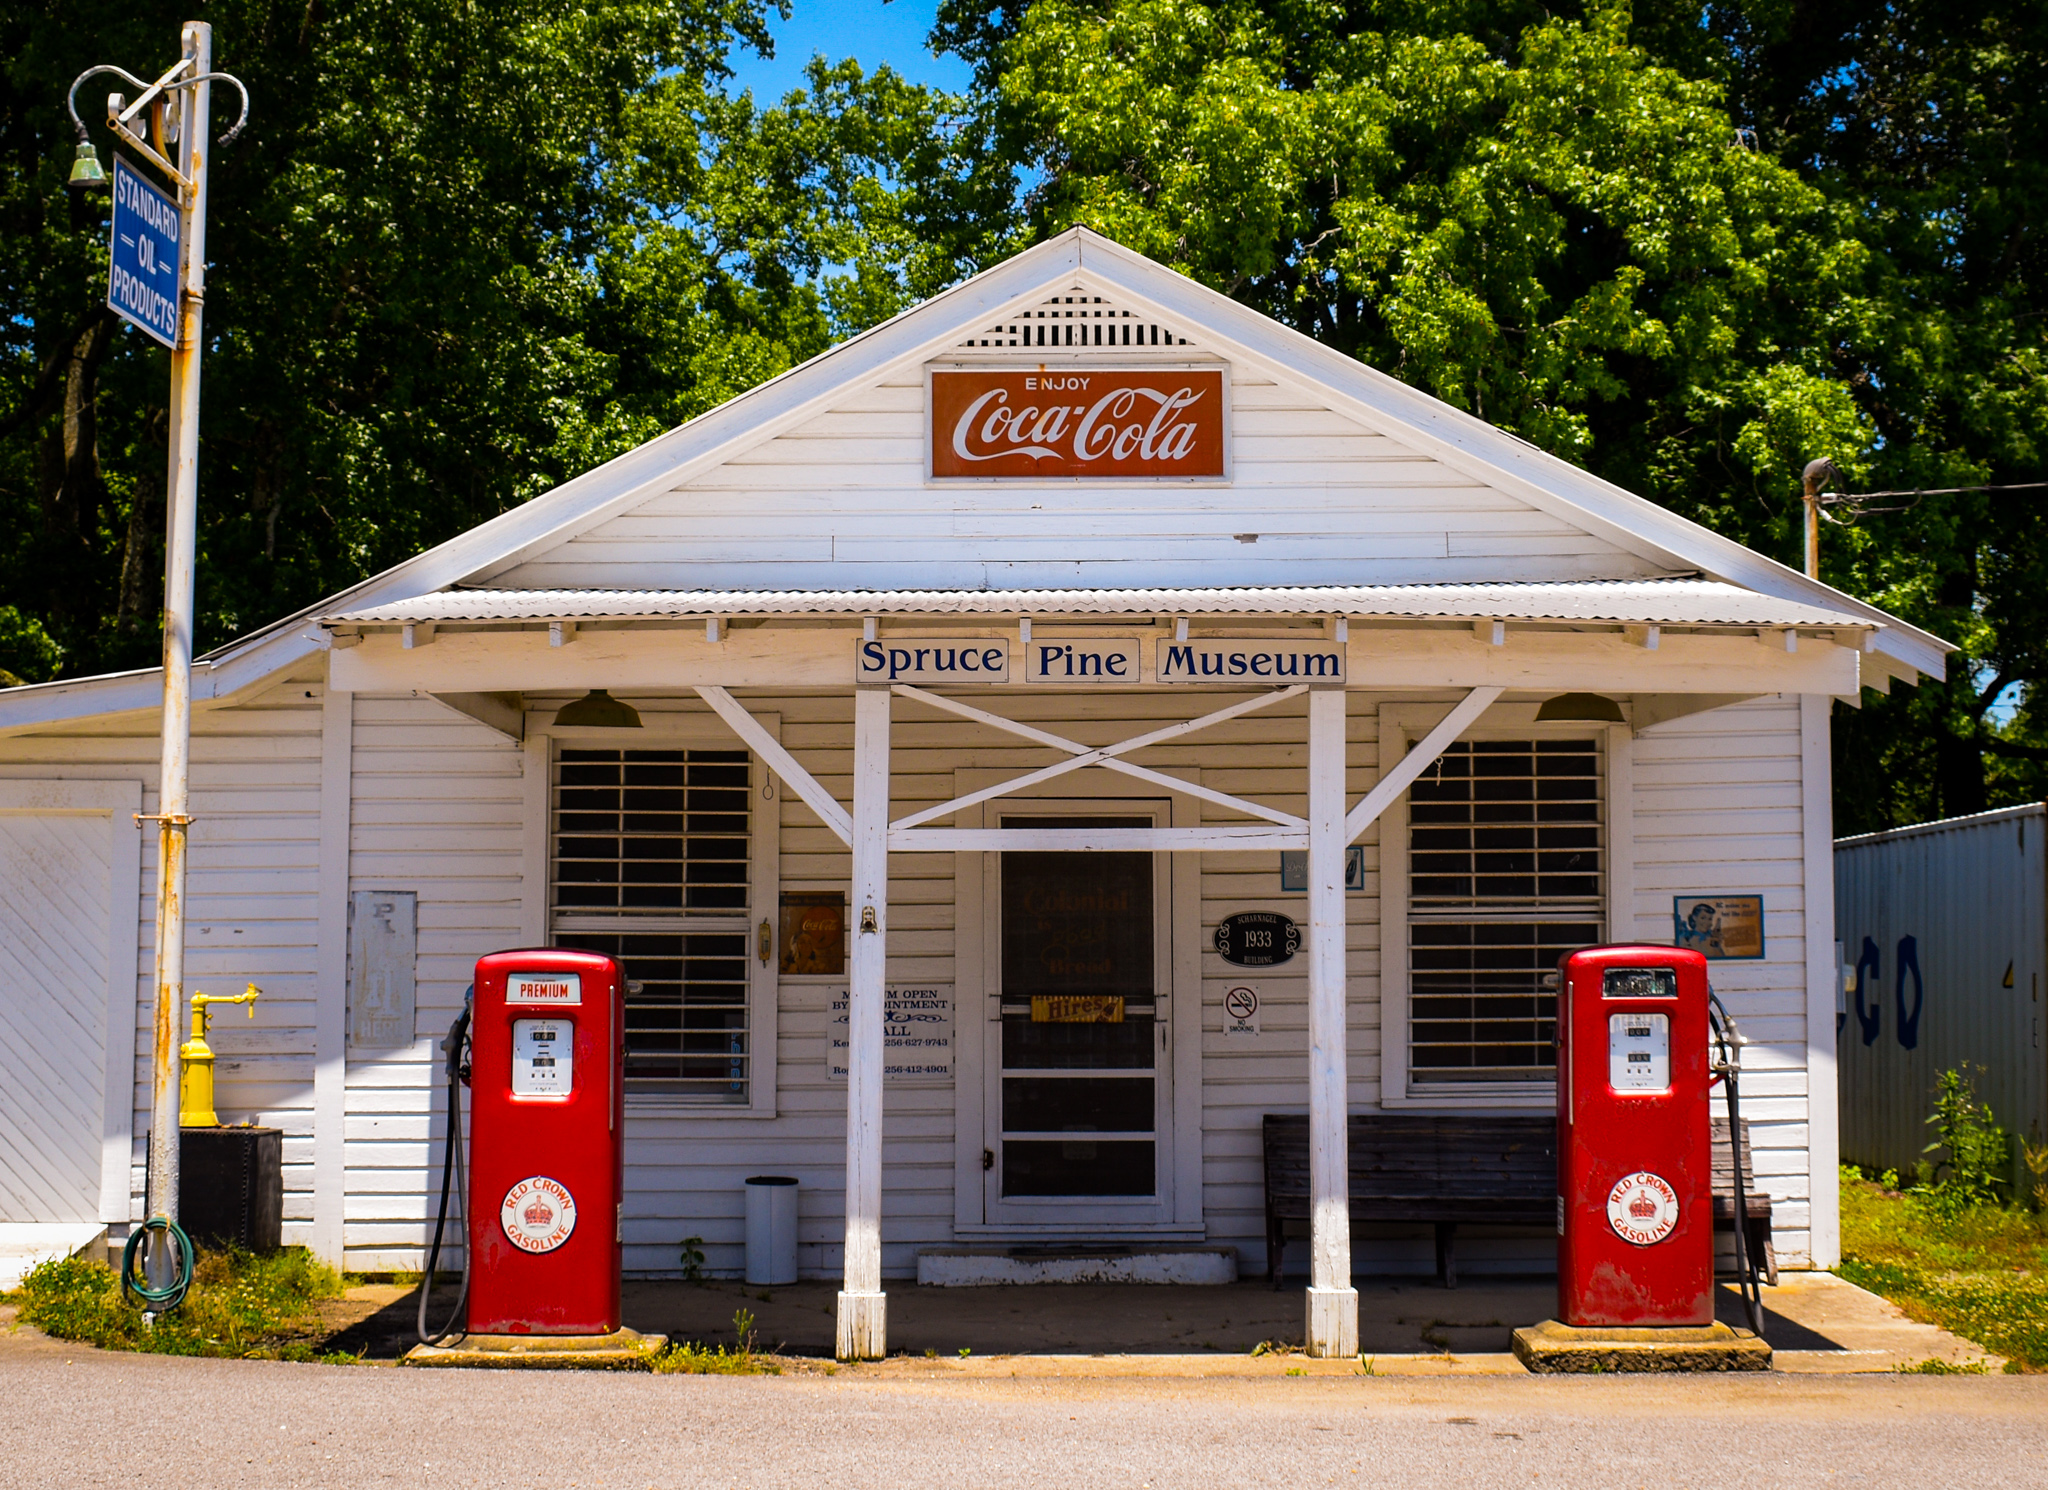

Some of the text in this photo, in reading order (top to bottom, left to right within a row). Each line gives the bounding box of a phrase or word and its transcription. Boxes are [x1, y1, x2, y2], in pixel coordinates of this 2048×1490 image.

[118, 170, 177, 243] STANDARD
[138, 233, 157, 275] OIL
[113, 264, 175, 335] PRODUCTS
[1025, 377, 1091, 391] ENJOY
[952, 387, 1207, 461] Coca-Cola
[861, 640, 1341, 680] Spruce Pine Museum
[1023, 887, 1129, 915] Colonial
[1244, 930, 1273, 948] 1933
[1243, 955, 1273, 965] BUILDING
[520, 983, 569, 998] PREMIUM
[903, 990, 938, 999] OPEN
[832, 1001, 848, 1010] BY
[1047, 997, 1103, 1020] Hires
[1229, 1025, 1254, 1033] SMOKING
[1237, 1018, 1246, 1026] NO
[884, 1038, 948, 1047] 256-627-9743
[884, 1065, 948, 1074] 256-412-4901
[505, 1178, 573, 1211] RED CROWN
[1611, 1175, 1675, 1203] RED CROWN
[506, 1223, 570, 1251] GASOLINE
[1614, 1217, 1673, 1242] GASOLINE
